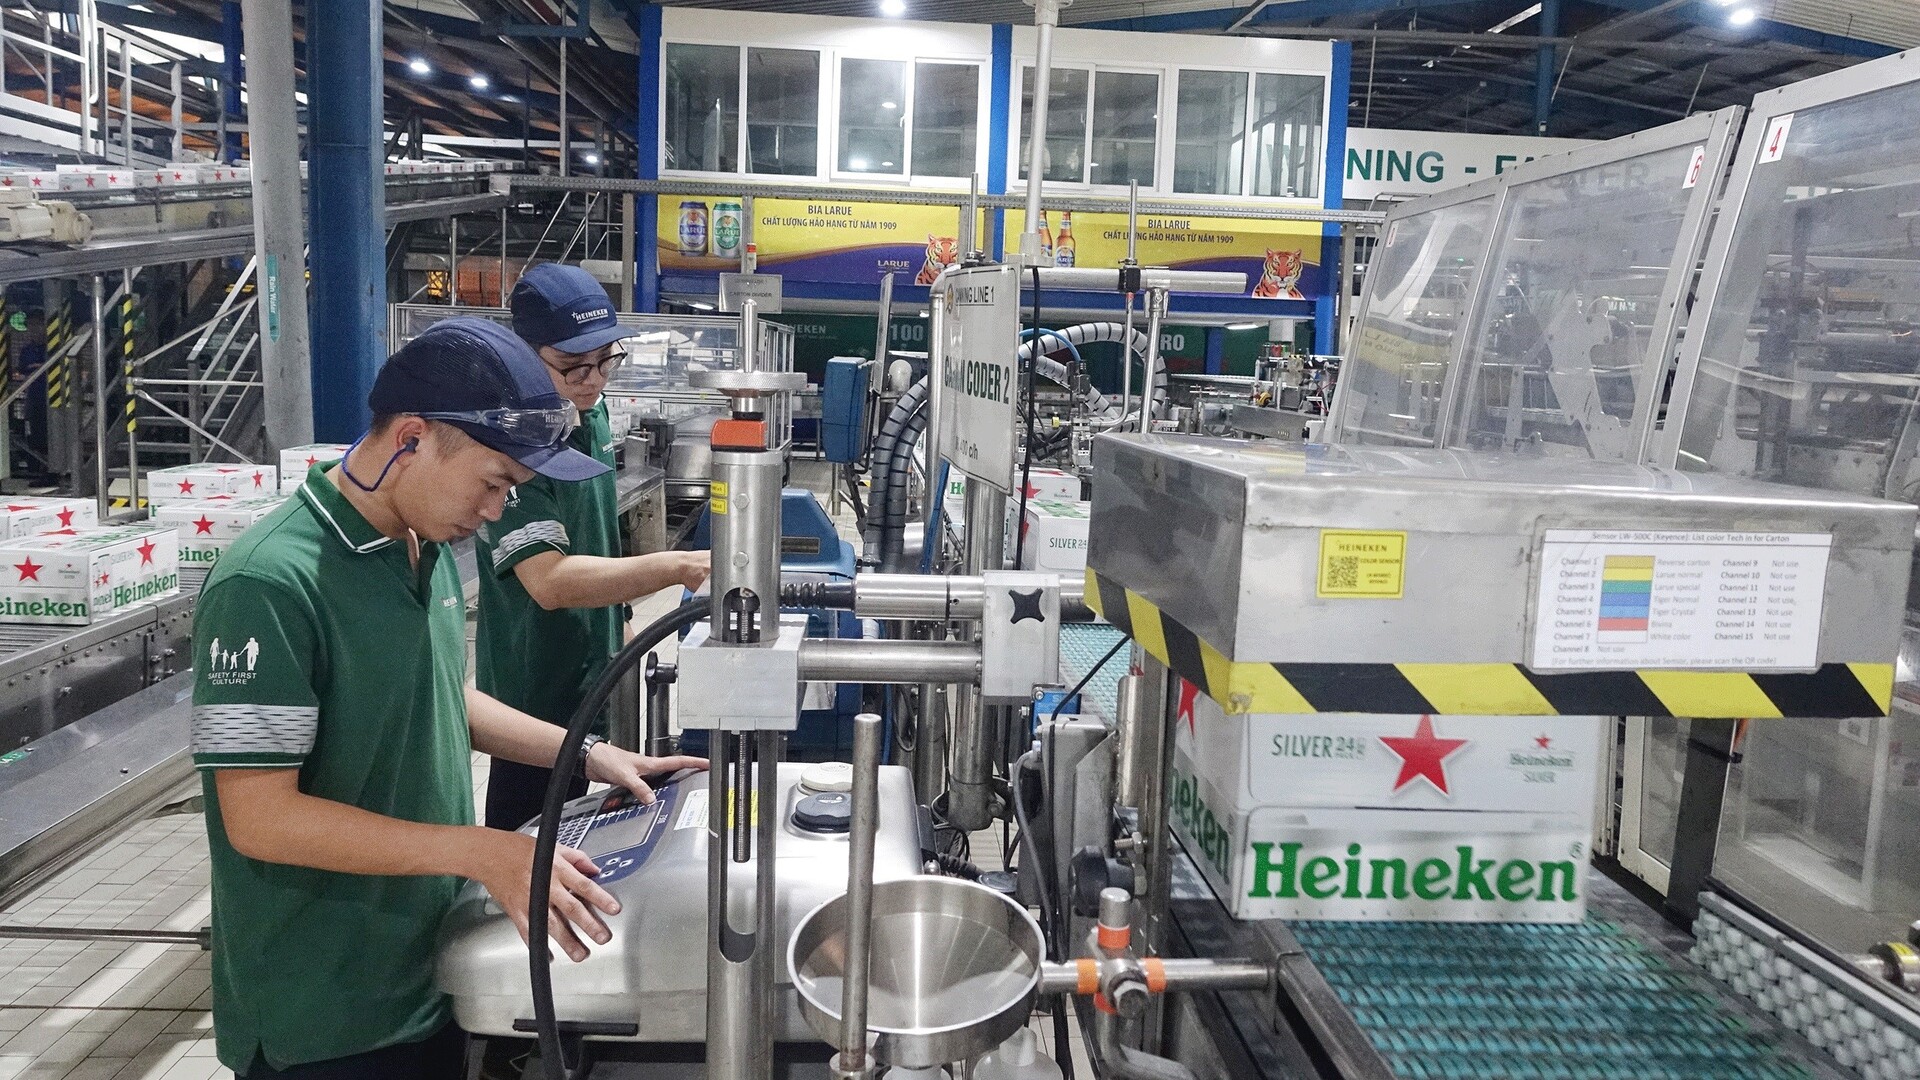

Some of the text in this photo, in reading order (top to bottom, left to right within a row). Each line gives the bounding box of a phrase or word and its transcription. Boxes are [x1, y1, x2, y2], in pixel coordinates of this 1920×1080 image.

[1769, 127, 1782, 158] 4
[1346, 148, 1445, 183] NING
[1690, 155, 1704, 184] 6
[808, 205, 852, 216] BIA LARUE
[762, 215, 780, 226] CHẤT
[879, 222, 897, 230] 1909
[1148, 219, 1190, 230] BIA LARUE
[1103, 229, 1120, 240] CHẤT
[1122, 231, 1146, 242] LNG
[1216, 236, 1234, 244] 1909
[878, 260, 909, 268] LARUE
[974, 286, 989, 303] LINE
[991, 286, 994, 302] 1
[576, 308, 608, 321] HEINEKEN
[890, 324, 924, 341] 100
[1160, 334, 1185, 351] RO
[966, 360, 1001, 402] CODER
[1003, 366, 1010, 405] 2
[1050, 537, 1077, 550] SILVER
[1726, 534, 1744, 542] Tech
[1338, 544, 1388, 552] HEINEKEN
[1561, 558, 1590, 566] Channel
[1560, 570, 1589, 578] Channel
[1751, 572, 1760, 580] 10
[113, 572, 178, 608] Heineken
[1558, 582, 1588, 590] Channel
[1750, 584, 1758, 592] 11
[1718, 596, 1758, 604] Channel 12
[0, 596, 88, 618] eineken
[1556, 608, 1586, 616] Channel
[1716, 608, 1746, 616] Channel
[1555, 620, 1584, 628] Channel
[1554, 632, 1583, 640] Channel
[208, 672, 257, 680] SAFETY FIRST
[212, 678, 248, 686] CULTURE
[1272, 734, 1333, 758] SILVER
[1510, 753, 1572, 768] Heineken
[1170, 767, 1230, 886] neken
[1248, 842, 1578, 902] Heineken
